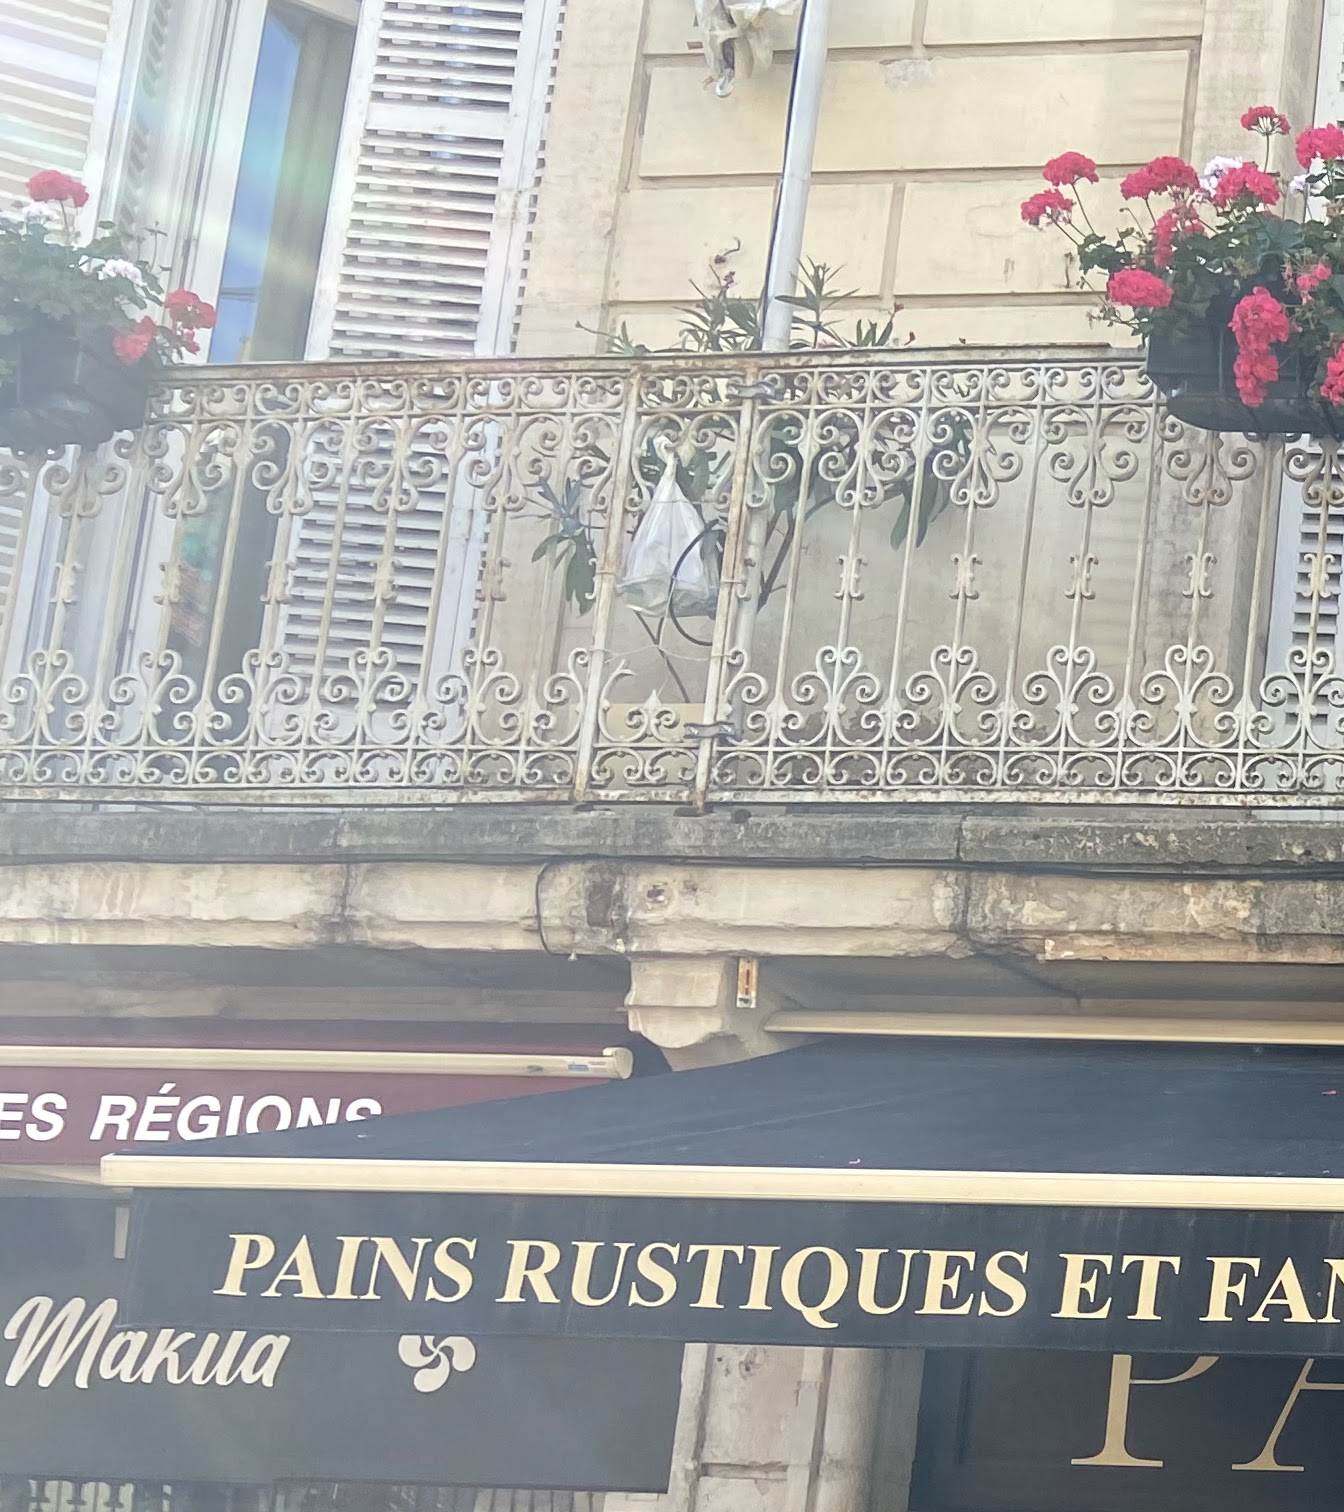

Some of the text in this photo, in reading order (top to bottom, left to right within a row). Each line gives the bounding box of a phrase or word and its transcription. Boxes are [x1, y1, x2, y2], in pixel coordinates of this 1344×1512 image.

[213, 1233, 476, 1303] PAINS
[497, 1239, 1028, 1328] RUSTIQUES
[1051, 1252, 1181, 1320] ET
